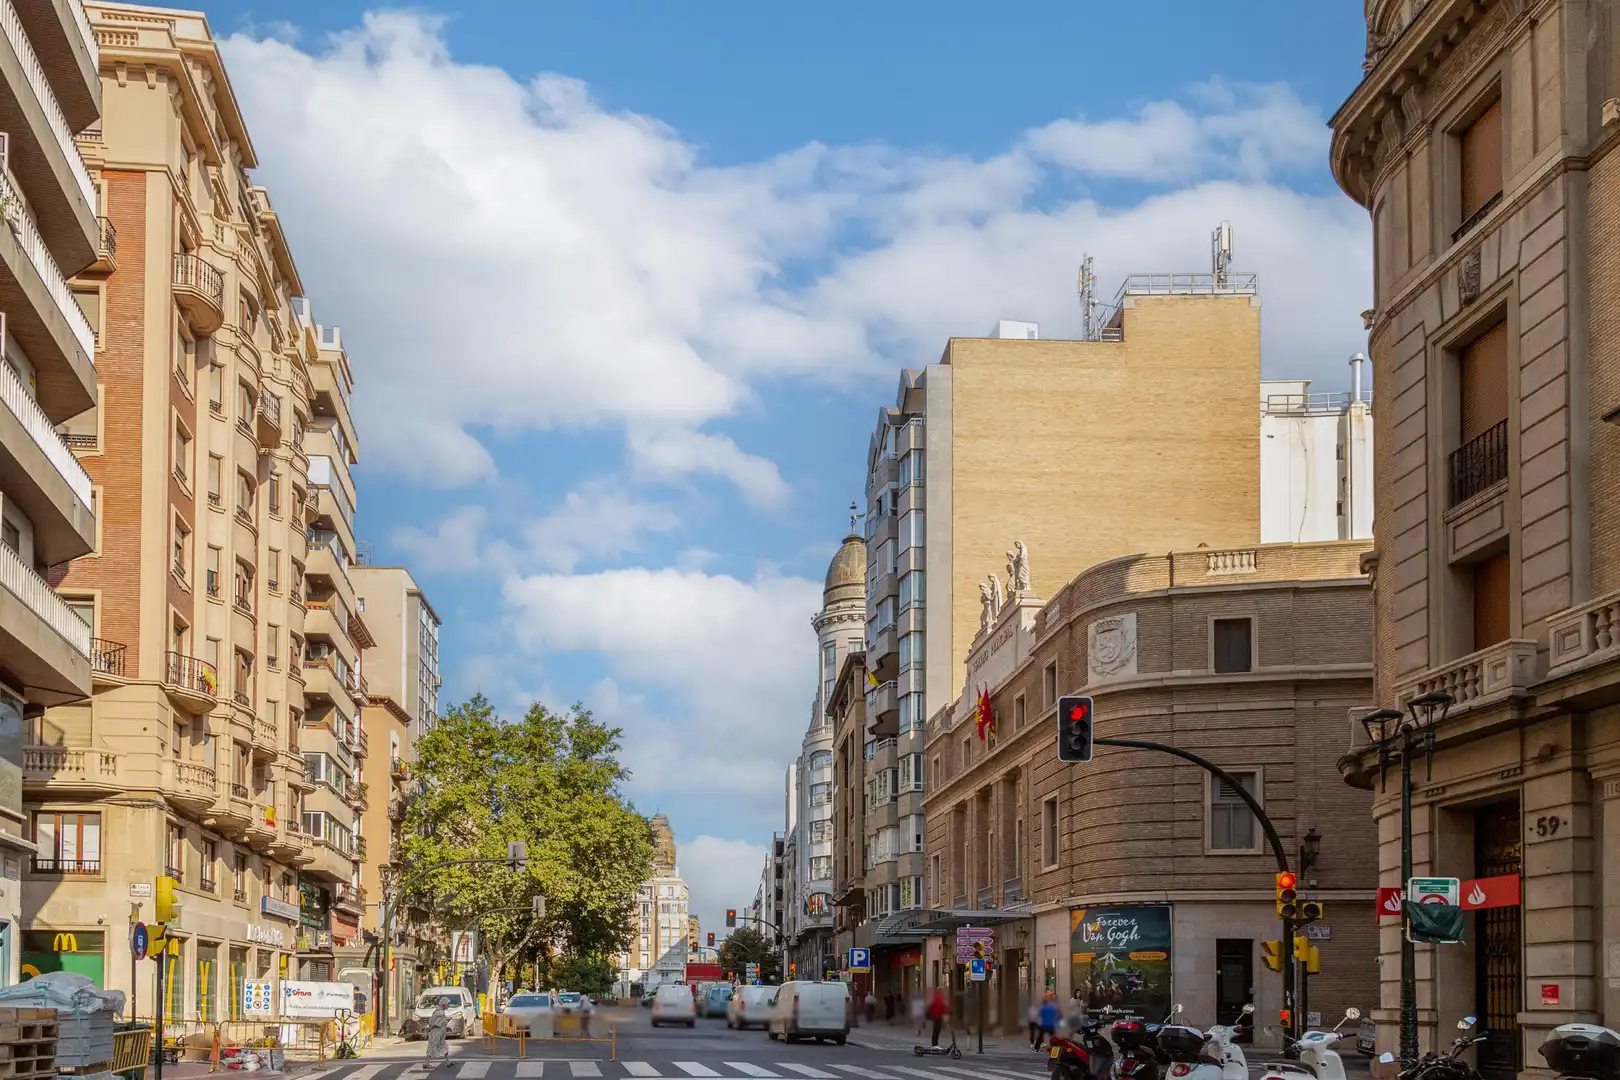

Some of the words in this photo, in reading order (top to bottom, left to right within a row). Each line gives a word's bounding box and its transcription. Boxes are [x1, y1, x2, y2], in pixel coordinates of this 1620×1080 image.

[1536, 815, 1560, 837] 59
[1096, 916, 1138, 927] Forever
[1083, 922, 1105, 943] Van
[1107, 925, 1141, 946] Gogh
[853, 950, 866, 966] P
